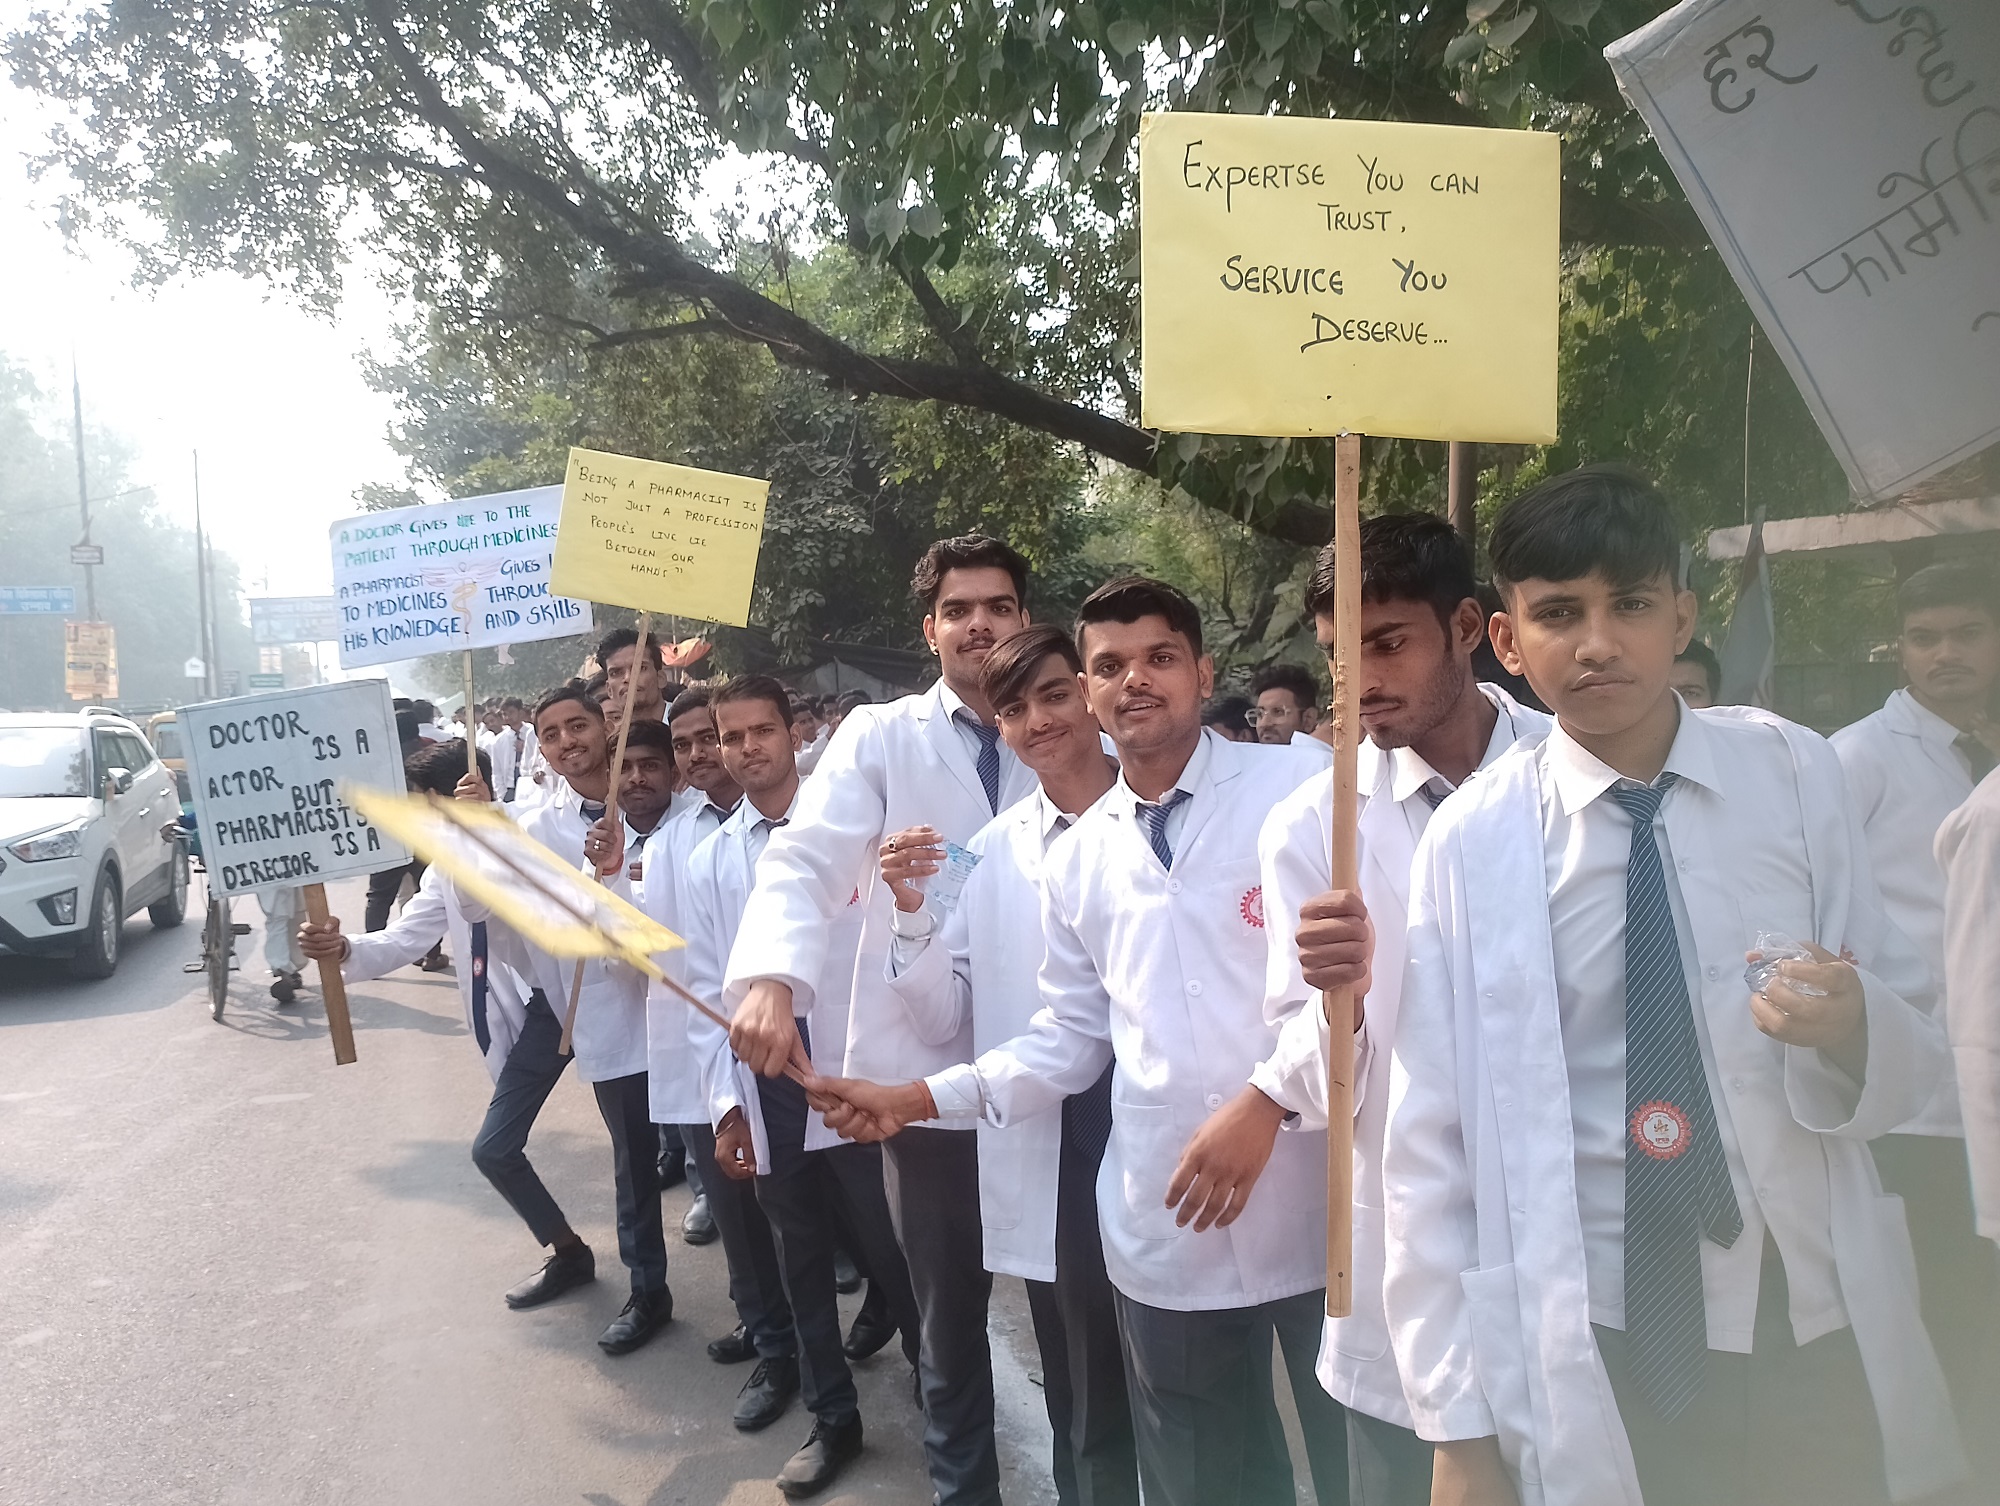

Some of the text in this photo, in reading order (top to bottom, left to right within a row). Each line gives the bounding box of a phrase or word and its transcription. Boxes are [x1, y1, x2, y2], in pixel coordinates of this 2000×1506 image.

[1702, 15, 1818, 114] हर
[1182, 139, 1479, 213] EXPERTSE YOU CAN
[1318, 202, 1407, 233] TRUST,
[1219, 254, 1447, 295] SERVICE YOU
[1300, 312, 1448, 353] DESERVE...
[582, 492, 758, 532] NOT JUST A PROFESSION
[628, 479, 636, 490] A
[649, 482, 730, 507] PHARMACIST
[742, 500, 757, 512] IS
[340, 530, 350, 544] A
[355, 523, 404, 542] DOCTOR
[409, 519, 447, 538] GIVES
[483, 510, 498, 522] TO
[506, 505, 532, 519] THE
[345, 546, 397, 567] PATIENT
[409, 535, 479, 557] THROUGH
[605, 539, 694, 565] BETWEEN OUR
[340, 586, 350, 599] A
[353, 573, 424, 597] PHARMACIST
[500, 559, 541, 580] GIVES
[341, 604, 360, 622] TO
[367, 591, 448, 618] MEDICINES
[344, 631, 368, 651] HIS
[485, 610, 520, 629] AND
[209, 710, 370, 761] DOCTOR IS A
[209, 766, 284, 798] ACTOR
[331, 832, 359, 857] IS
[366, 826, 381, 852] A
